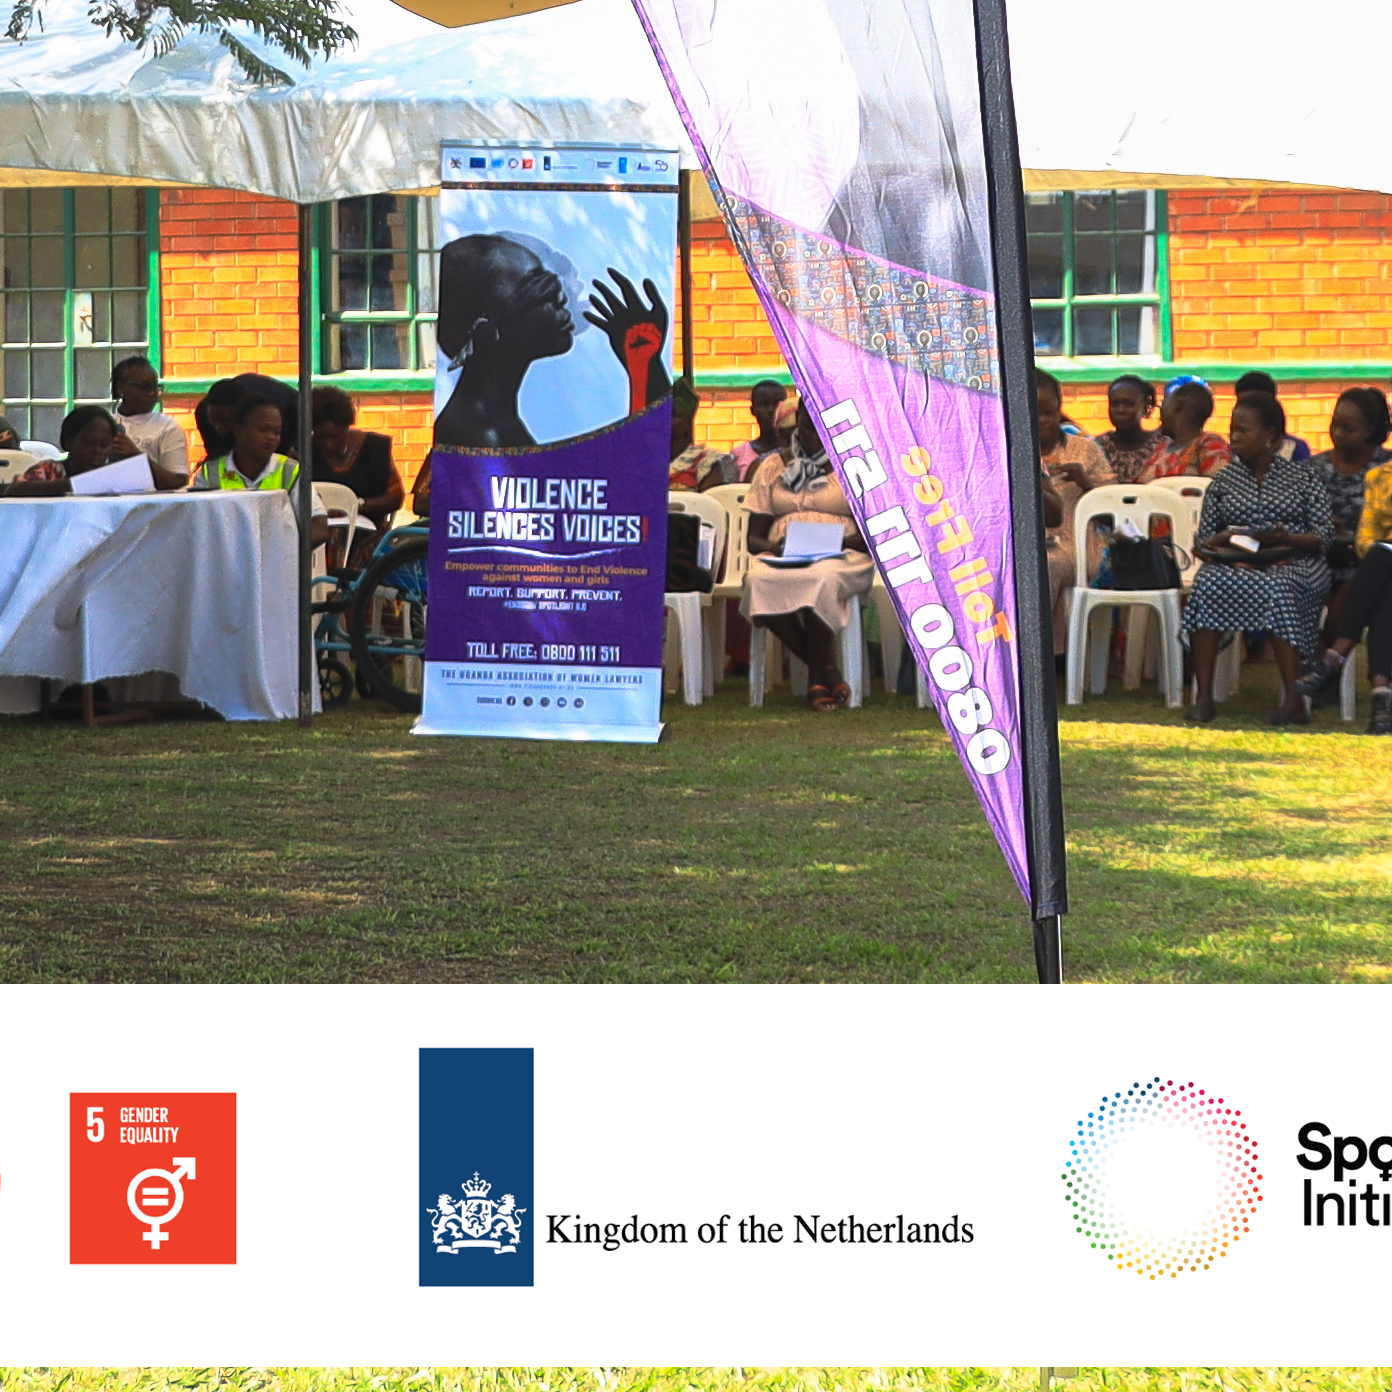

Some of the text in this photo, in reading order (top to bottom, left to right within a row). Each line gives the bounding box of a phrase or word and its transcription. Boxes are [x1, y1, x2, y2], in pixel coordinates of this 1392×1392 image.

[491, 476, 608, 510] VIOLENCE
[448, 511, 649, 543] SILENCES VOICES!
[445, 561, 648, 576] Empower communities to End Violence
[482, 572, 610, 586] against women and girls
[468, 586, 513, 599] REPORT.
[516, 587, 569, 600] SUPPORT.
[466, 641, 621, 663] TOLL FREE: 0800 111 511
